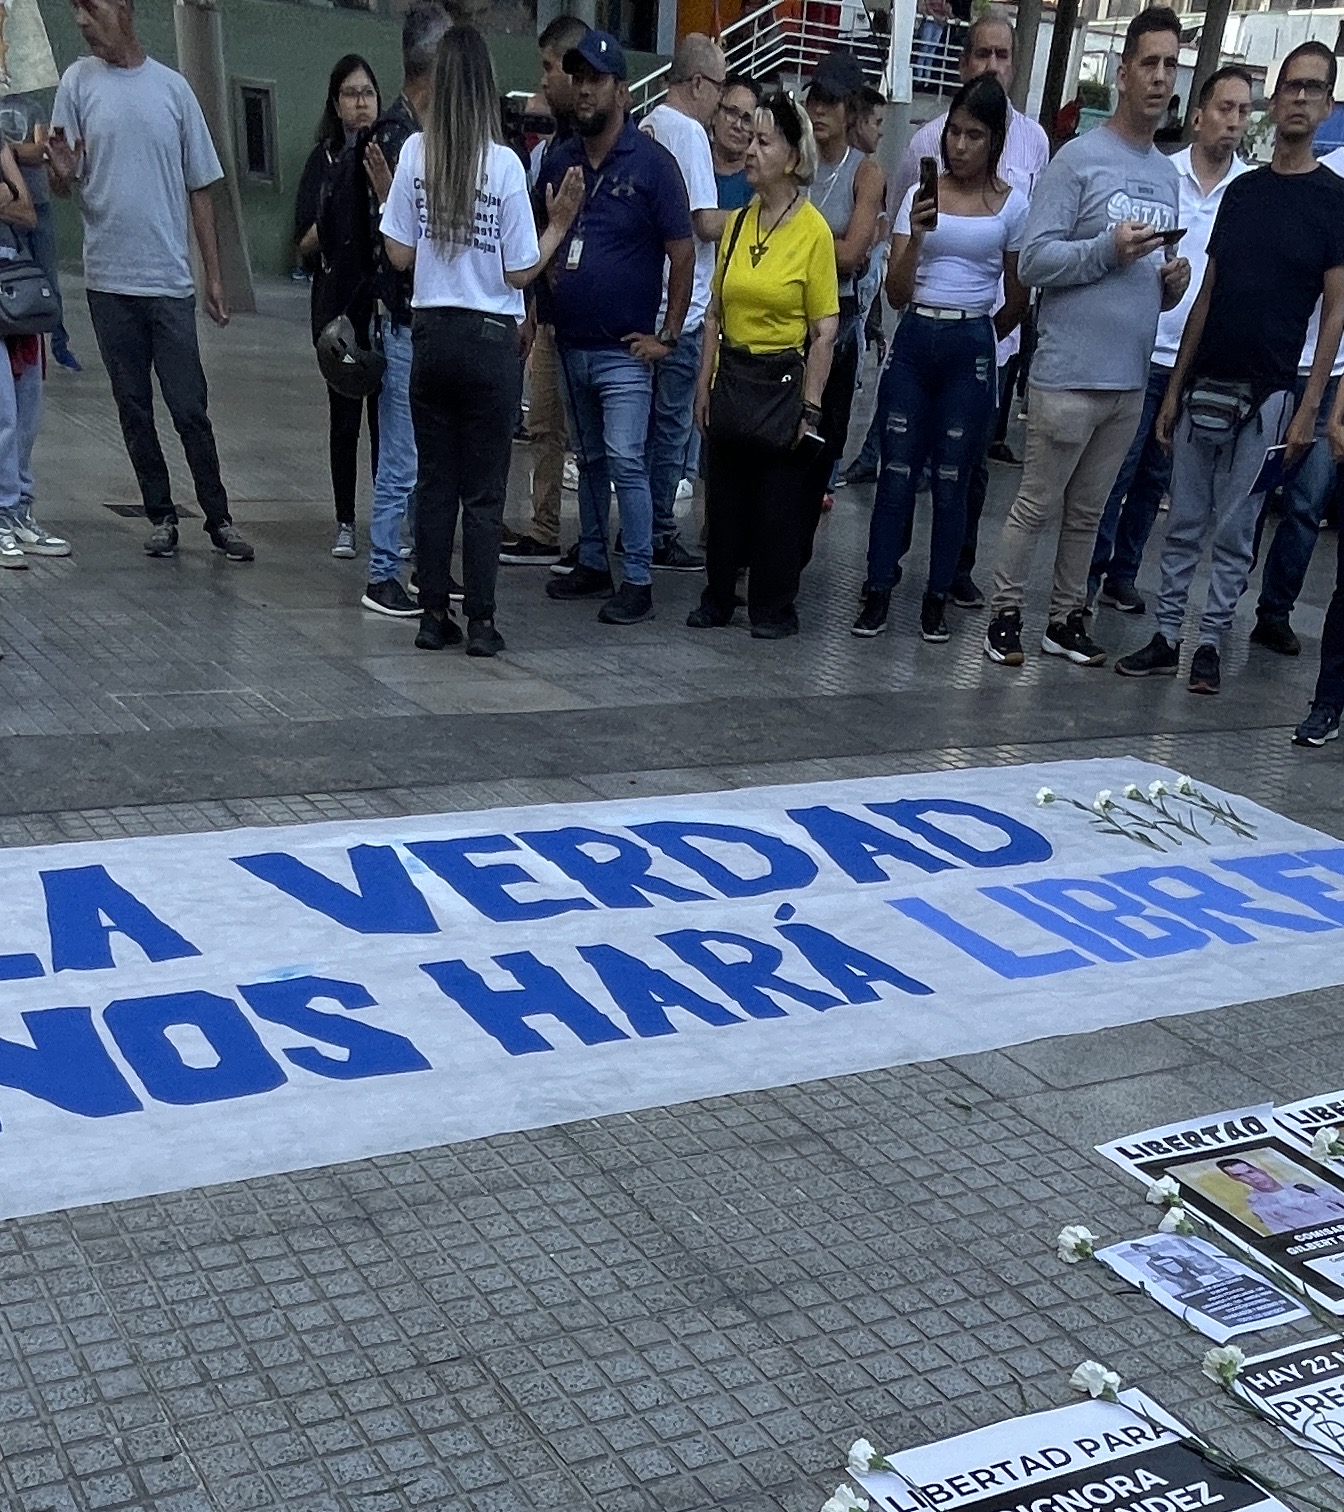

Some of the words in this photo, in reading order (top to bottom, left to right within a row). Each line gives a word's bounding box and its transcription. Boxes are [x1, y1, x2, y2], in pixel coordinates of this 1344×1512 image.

[233, 797, 1054, 935] VERDAD
[417, 901, 933, 1057] HARÁ
[1115, 1115, 1269, 1161] LIBERTAD
[1245, 1363, 1304, 1392] HAY
[1301, 1357, 1339, 1376] 22
[1080, 1420, 1175, 1464] PARA
